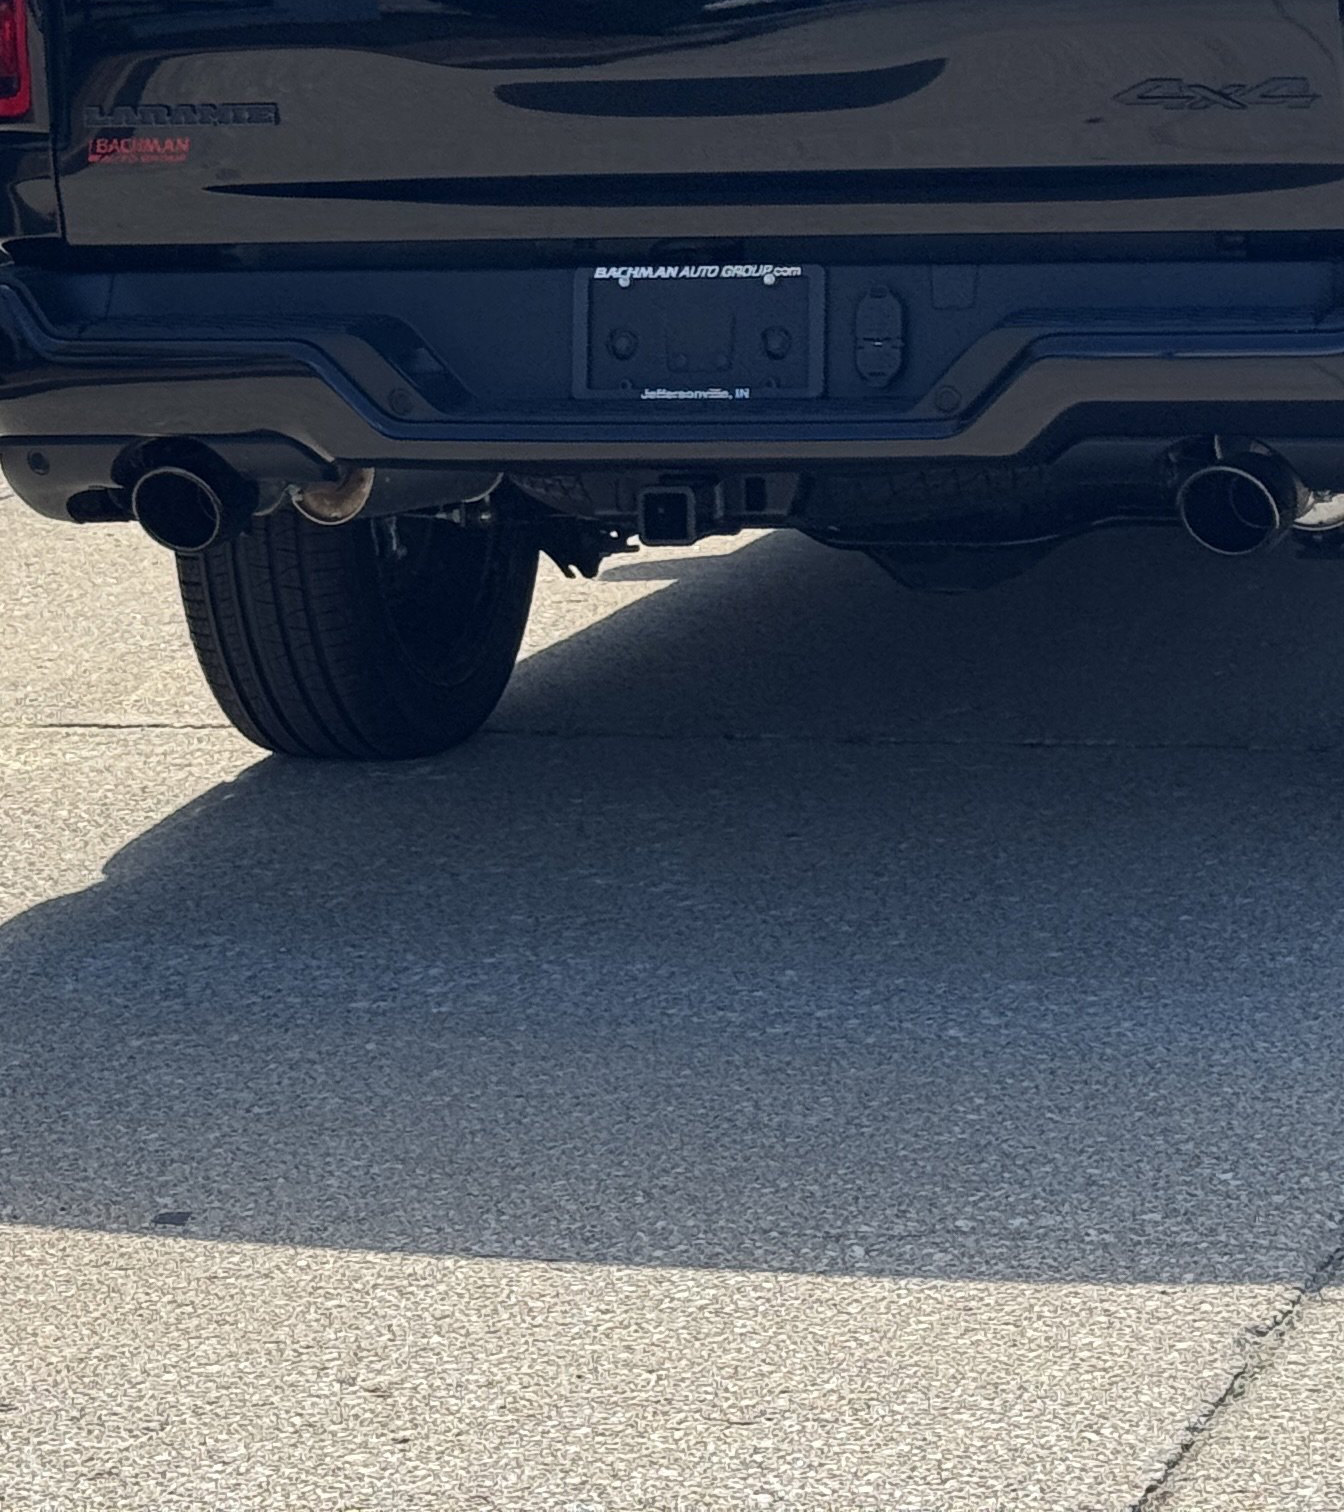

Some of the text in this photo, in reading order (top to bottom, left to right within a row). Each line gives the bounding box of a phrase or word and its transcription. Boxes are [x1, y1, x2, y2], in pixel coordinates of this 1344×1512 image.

[84, 102, 280, 128] LARAMIE
[95, 136, 191, 154] BACHMAN
[594, 266, 678, 279] BACHMAN
[679, 265, 720, 278] AUTO
[735, 387, 750, 399] IN
